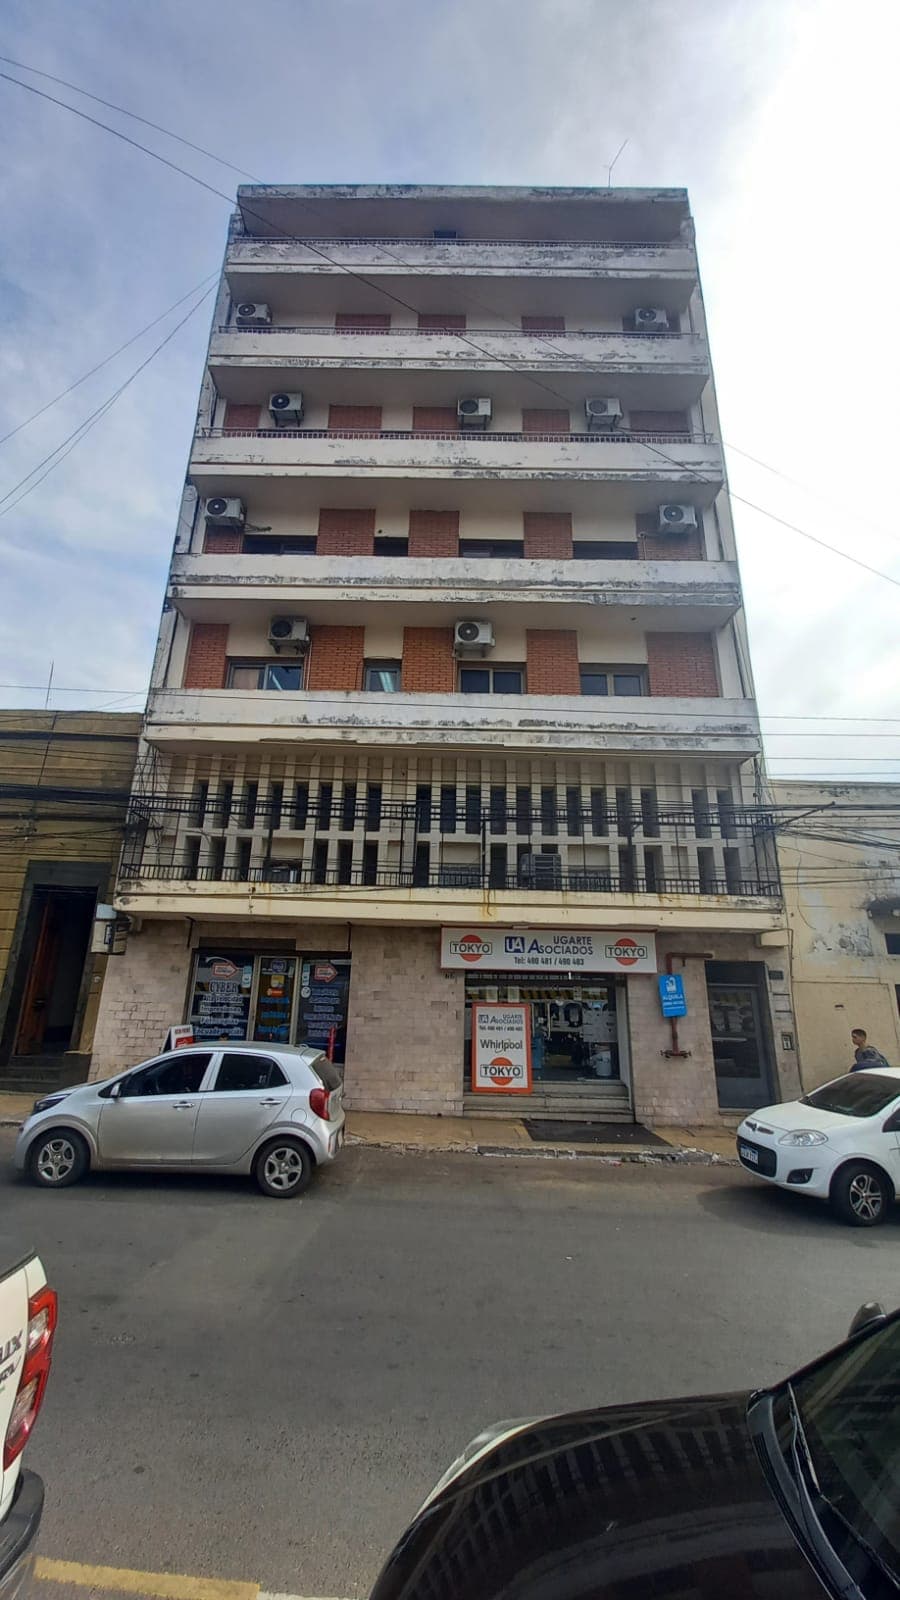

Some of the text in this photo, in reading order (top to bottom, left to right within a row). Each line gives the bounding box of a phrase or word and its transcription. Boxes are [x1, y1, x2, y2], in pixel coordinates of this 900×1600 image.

[553, 935, 592, 945] UGARTE
[453, 943, 490, 953] TOKYO
[607, 946, 645, 957] TOKYO
[514, 956, 526, 965] Tel:
[209, 980, 238, 993] CYBER
[480, 1039, 523, 1052] Whirlpool
[483, 1066, 521, 1076] TOKYO
